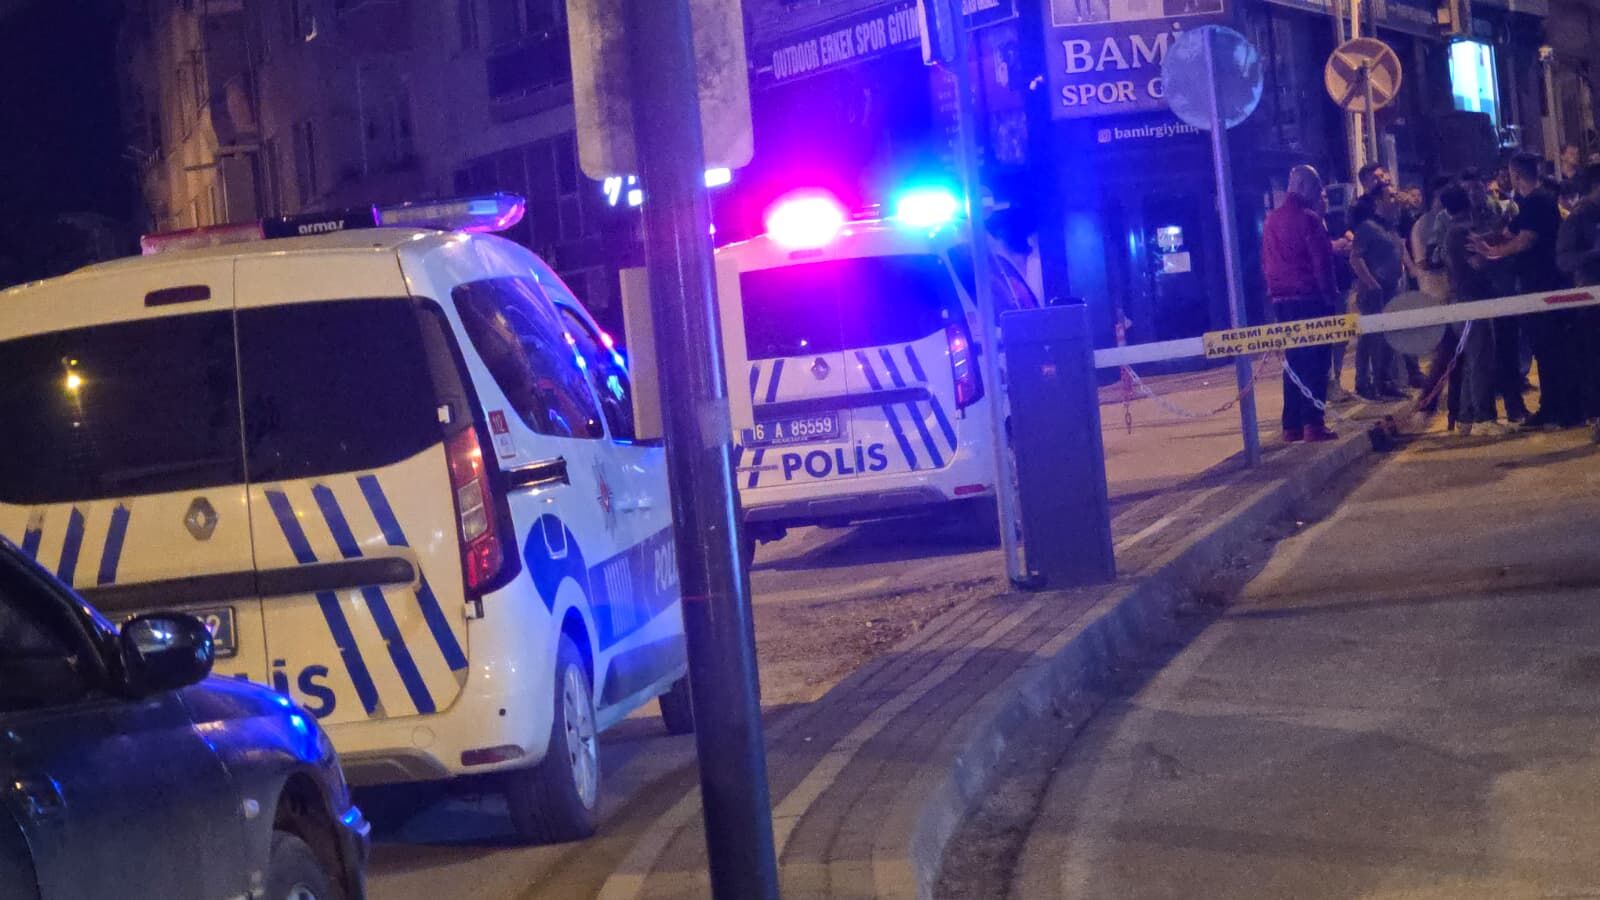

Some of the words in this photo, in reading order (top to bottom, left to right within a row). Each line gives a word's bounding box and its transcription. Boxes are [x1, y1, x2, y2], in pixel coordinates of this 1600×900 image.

[773, 39, 820, 80] OUTDOOR
[820, 27, 856, 66] ERKEK
[855, 17, 888, 55] SPOR
[1062, 81, 1137, 106] SPOR
[1207, 344, 1243, 357] ARAÇ
[774, 421, 784, 439] A
[791, 416, 832, 438] 85559
[782, 440, 888, 480] POLİS
